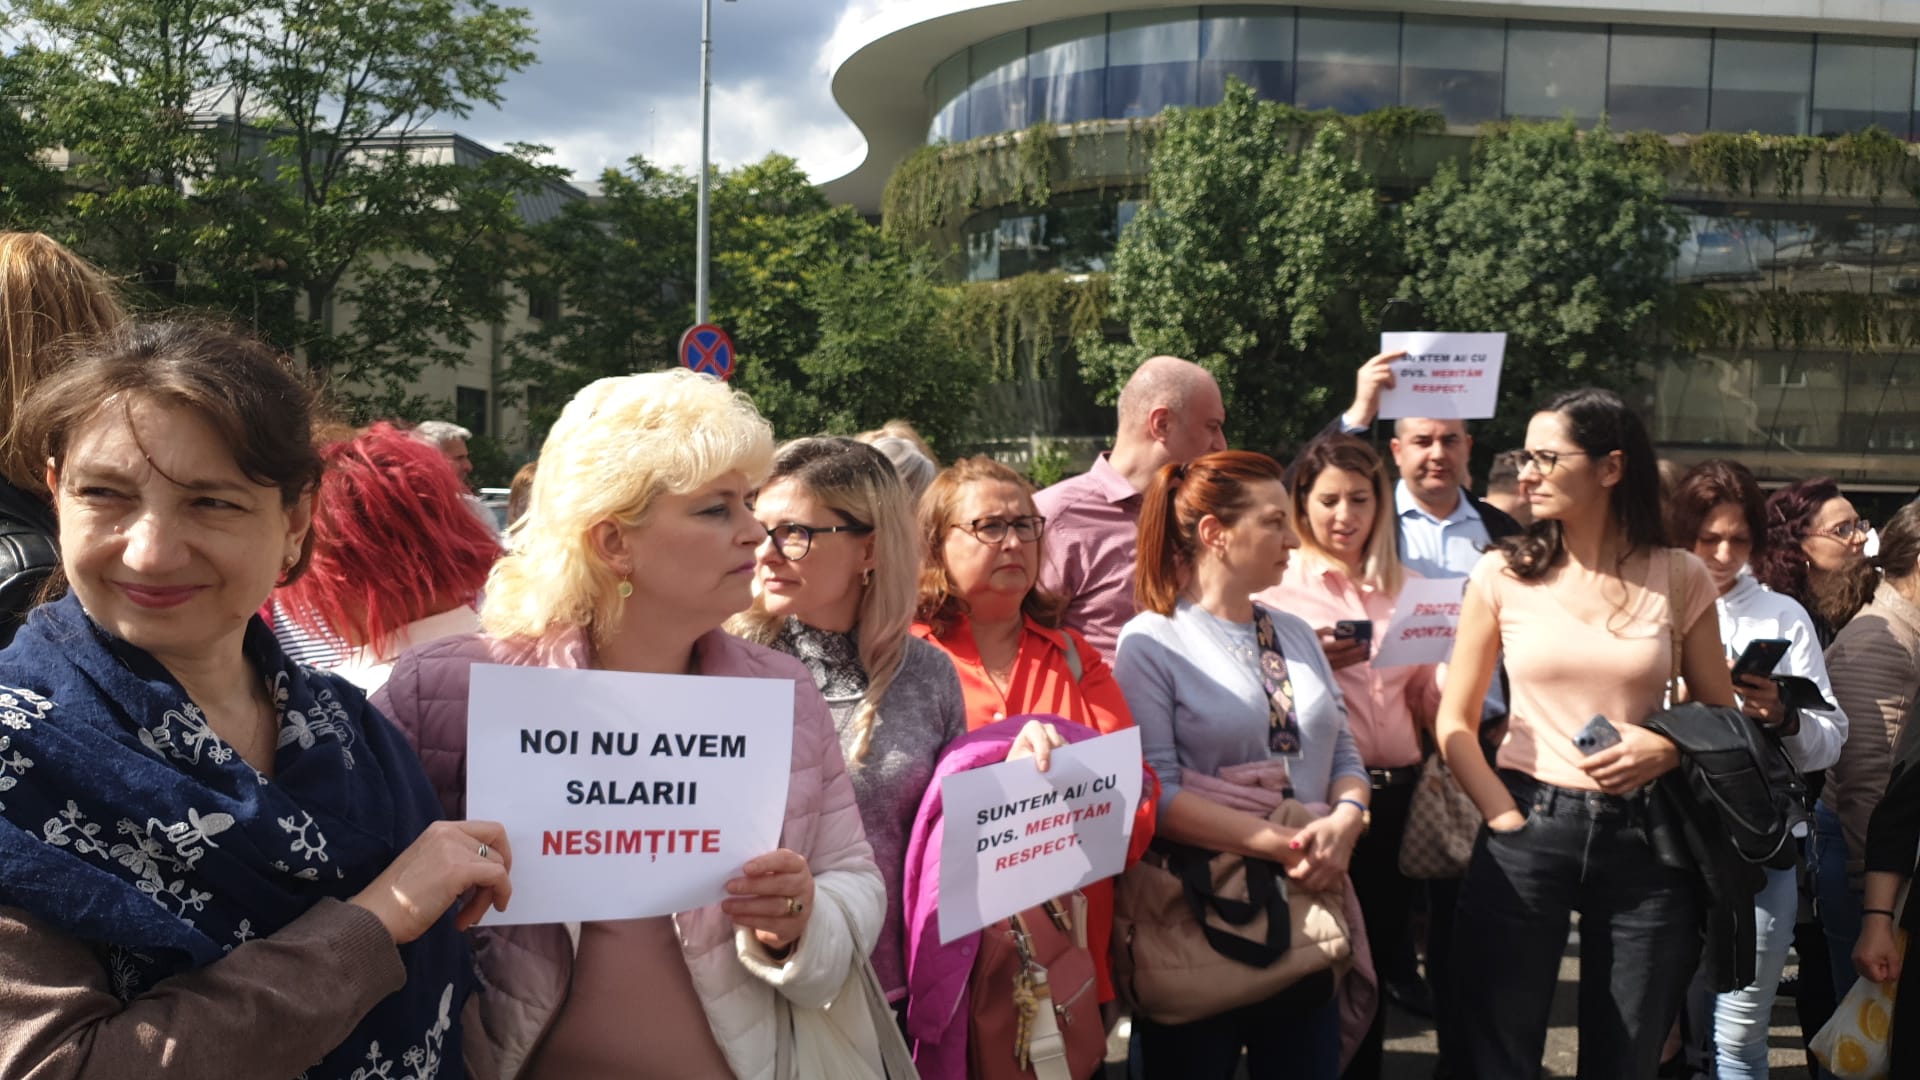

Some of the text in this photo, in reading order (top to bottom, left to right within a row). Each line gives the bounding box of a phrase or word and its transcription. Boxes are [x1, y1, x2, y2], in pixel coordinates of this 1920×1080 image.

[1471, 353, 1487, 362] CU
[521, 729, 746, 758] NOI NU AVEM
[566, 780, 697, 805] SALARII
[976, 774, 1117, 825] SUNTEM AI/ CU
[976, 801, 1112, 852] DVS. MERITĂM
[542, 829, 721, 863] NESIMȚITE
[995, 833, 1083, 872] RESPECT.
